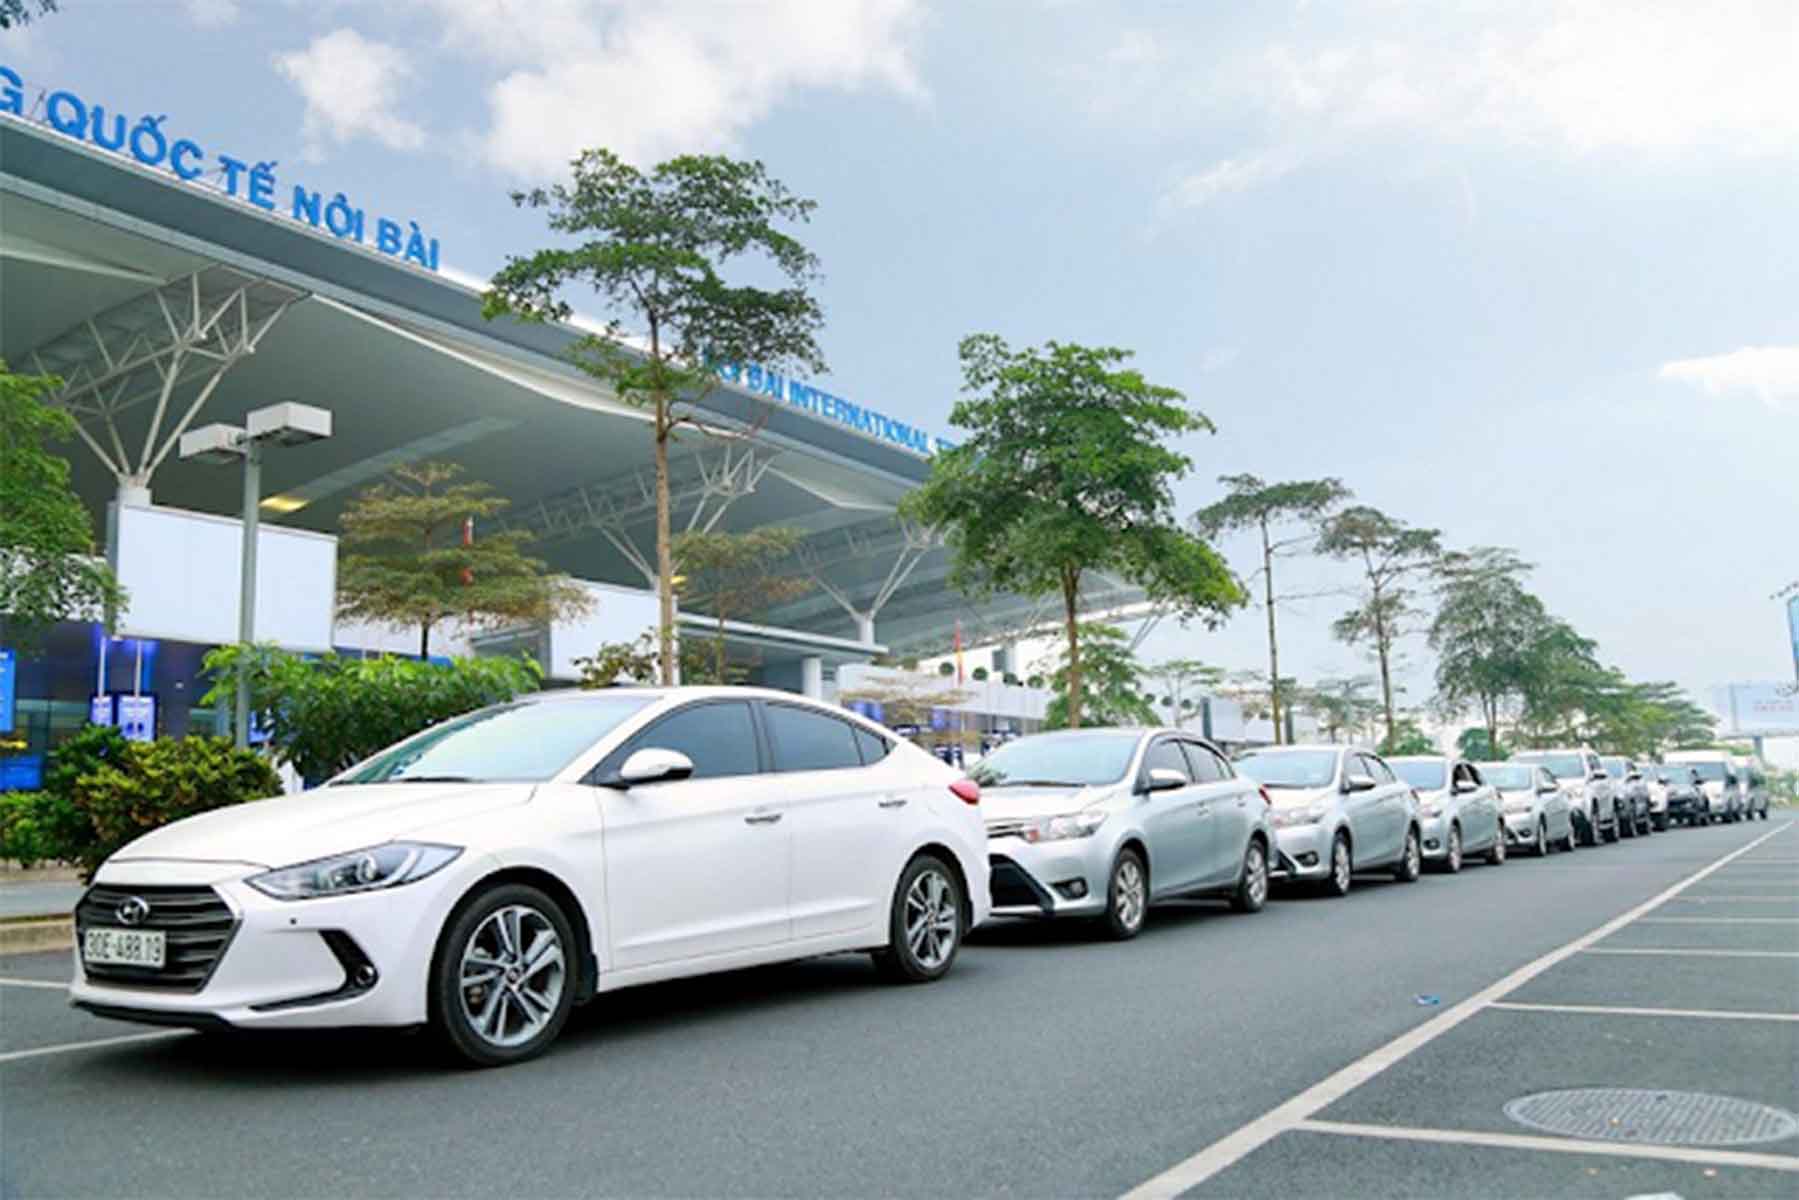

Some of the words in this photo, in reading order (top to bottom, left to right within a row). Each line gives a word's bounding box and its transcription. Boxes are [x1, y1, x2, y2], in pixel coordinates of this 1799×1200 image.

[46, 90, 204, 181] QUỐC
[218, 158, 279, 211] TẾ
[376, 217, 441, 271] BÀI
[789, 380, 929, 453] INTERNATIONAL
